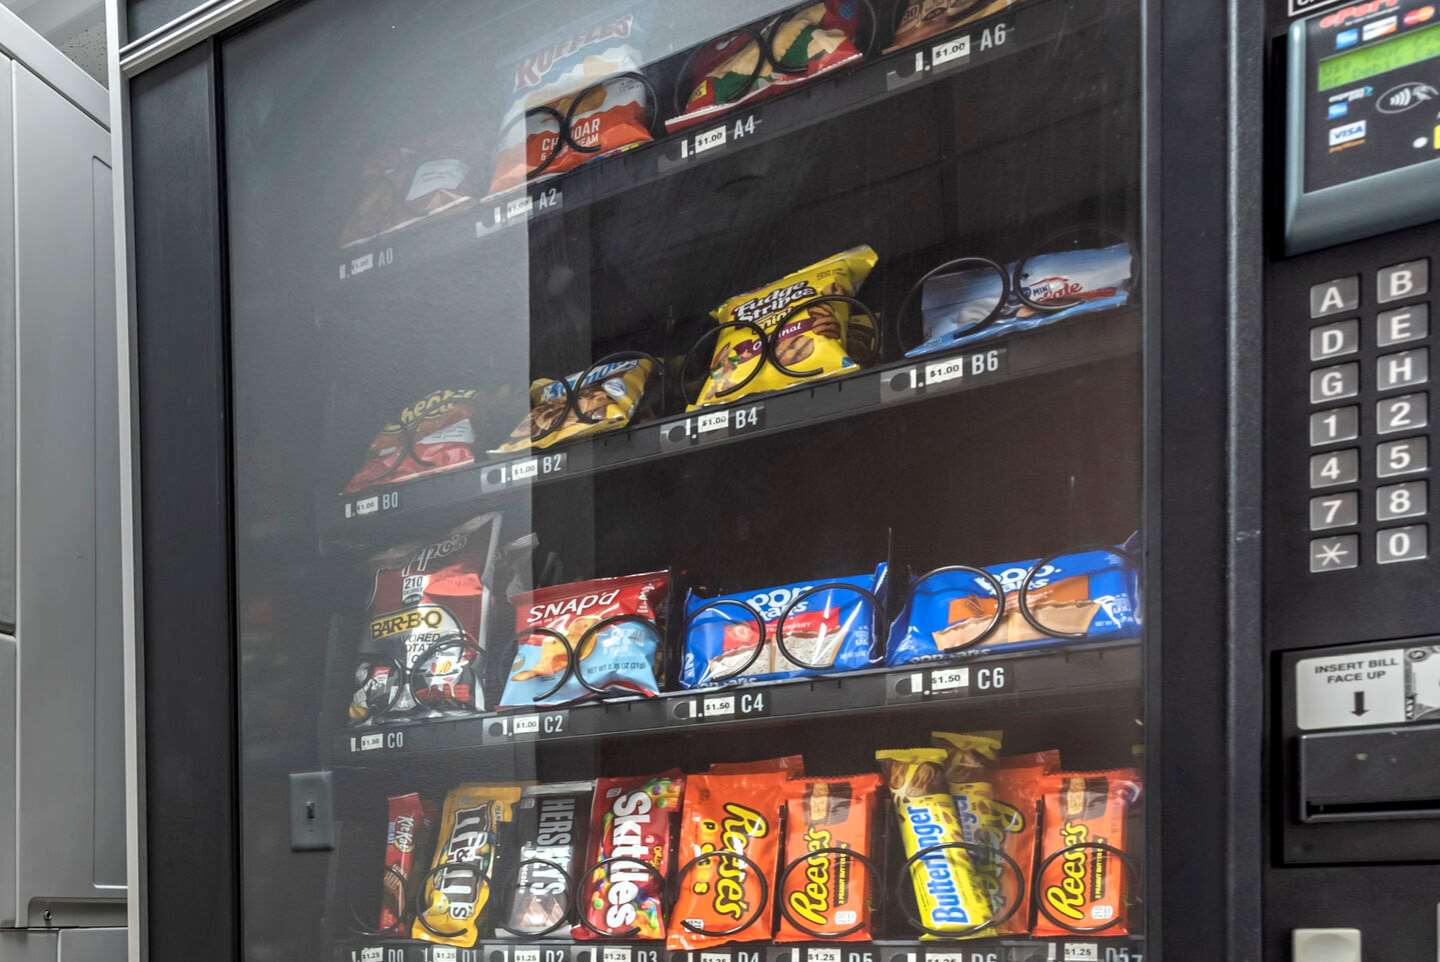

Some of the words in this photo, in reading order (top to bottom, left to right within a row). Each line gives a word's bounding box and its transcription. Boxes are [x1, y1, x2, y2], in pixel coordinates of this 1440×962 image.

[935, 43, 965, 58] $1.00
[980, 23, 1006, 51] A6
[697, 131, 723, 147] $1.00
[734, 115, 755, 140] A4
[1334, 125, 1364, 140] VISA
[538, 187, 557, 211] A2
[1390, 270, 1413, 297] B
[734, 281, 808, 317] Fudge
[739, 288, 816, 323] Stripes
[1320, 286, 1344, 313] A
[1391, 314, 1412, 340] E
[1321, 330, 1344, 354] D
[929, 365, 960, 377] $1.00
[972, 351, 998, 375] B6
[1389, 357, 1412, 383] H
[1321, 371, 1343, 396] G
[702, 415, 727, 427] $1.00
[735, 407, 758, 429] B4
[1323, 415, 1337, 438] 1
[1390, 402, 1411, 427] 2
[543, 454, 562, 474] B2
[1321, 457, 1340, 479] 4
[1390, 445, 1410, 470] 5
[382, 492, 399, 510] B0
[1322, 500, 1342, 523] 7
[1389, 489, 1410, 513] 8
[1389, 533, 1410, 556] 0
[371, 609, 442, 640] BAR-B-Q
[1314, 660, 1364, 674] INSERT
[1368, 657, 1398, 669] BILL
[1327, 672, 1363, 684] FACE
[1367, 670, 1386, 681] UP
[931, 674, 961, 685] $1.50
[977, 667, 1005, 690] C6
[705, 703, 730, 711] $1.50
[741, 694, 764, 713] C4
[544, 715, 564, 733] C2
[387, 732, 404, 749] C0
[607, 791, 653, 928] Skittles
[714, 802, 768, 919] Reese's
[1047, 822, 1090, 919] Reese's
[790, 828, 831, 925] Reese's
[808, 954, 835, 962] $1.25
